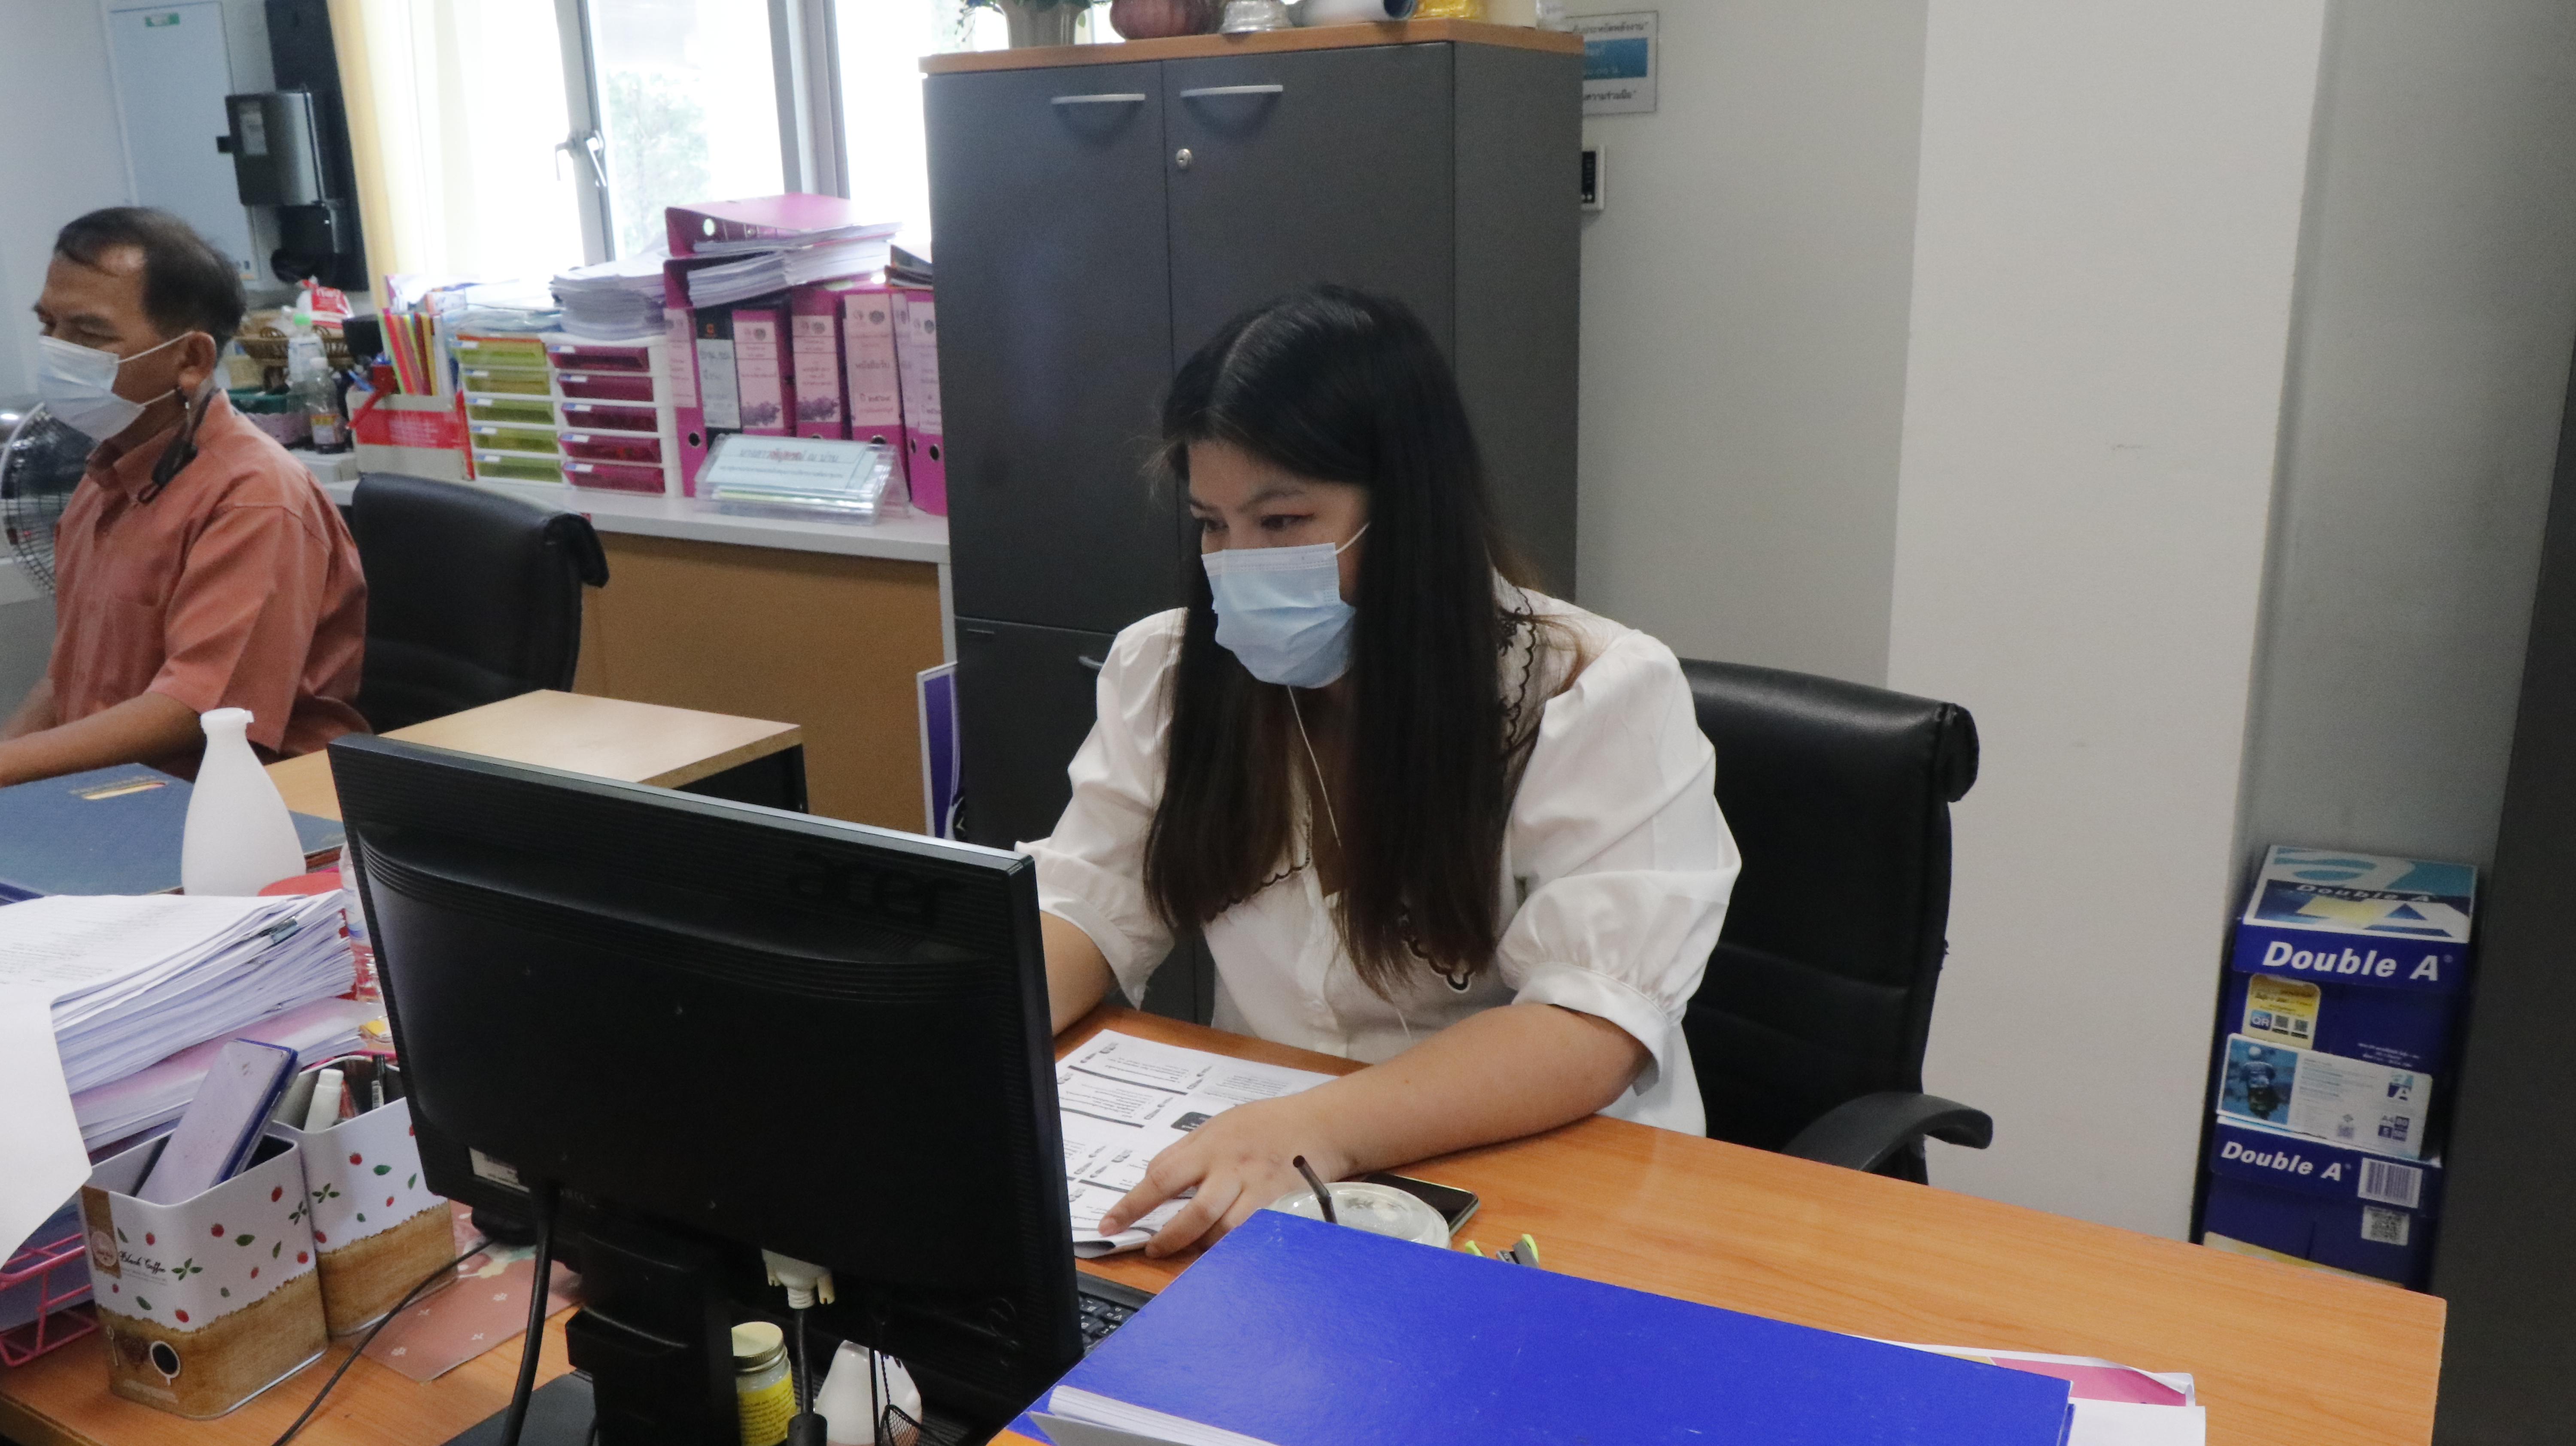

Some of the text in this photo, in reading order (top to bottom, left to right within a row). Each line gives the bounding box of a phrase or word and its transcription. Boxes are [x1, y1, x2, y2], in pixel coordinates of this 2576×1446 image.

[787, 850, 962, 928] acer
[2296, 884, 2399, 900] Double
[2262, 941, 2439, 981] Double A
[2221, 1140, 2342, 1182] Double A
